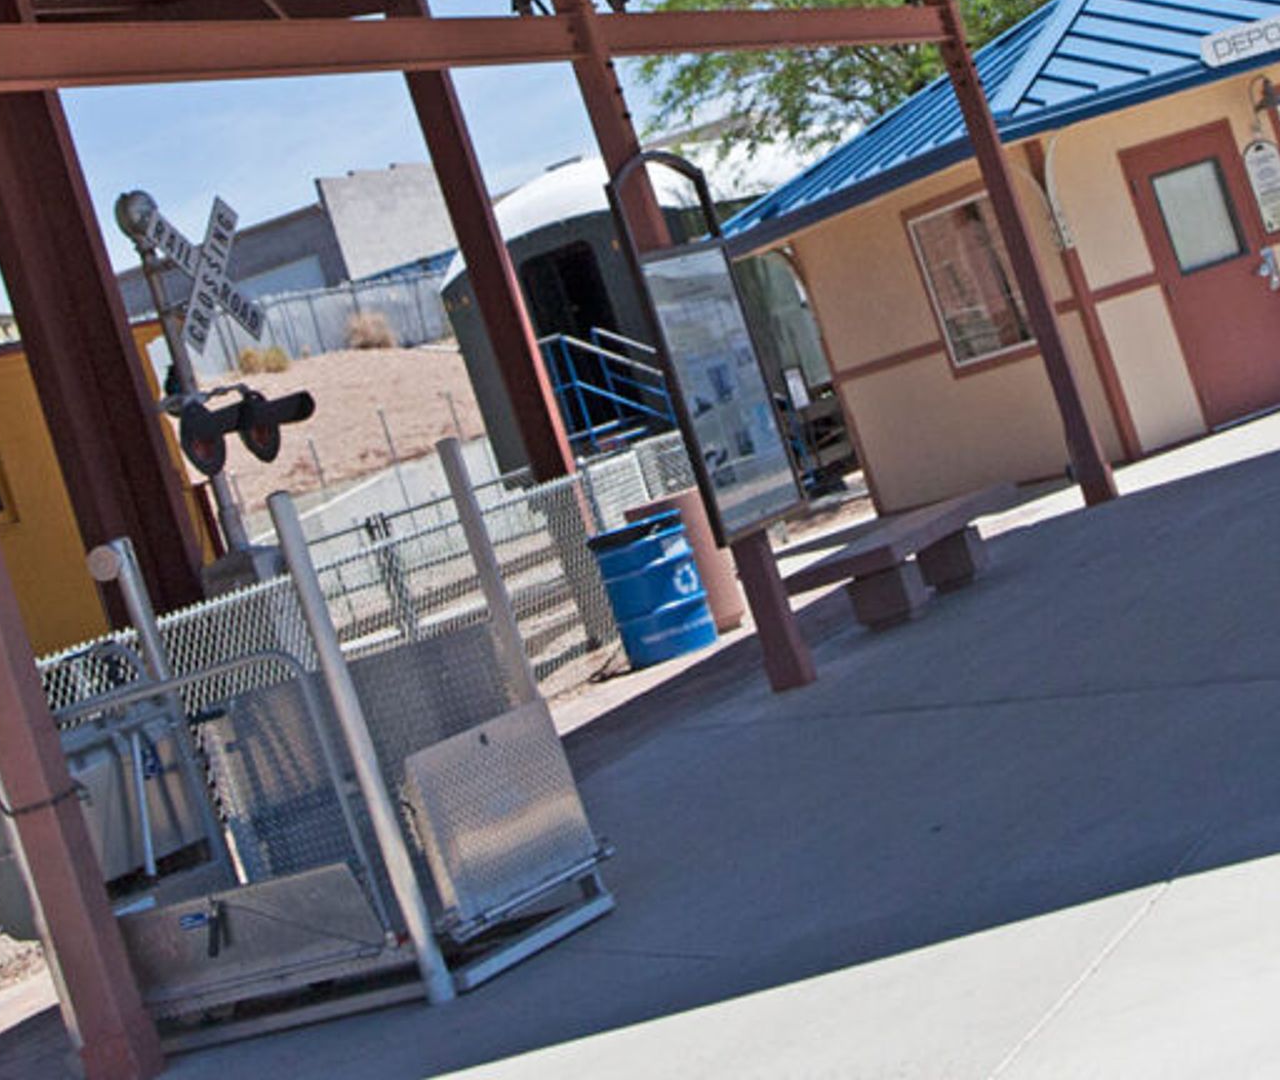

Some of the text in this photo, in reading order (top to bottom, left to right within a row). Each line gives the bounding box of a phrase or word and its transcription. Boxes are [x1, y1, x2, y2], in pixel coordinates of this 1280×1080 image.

[154, 219, 261, 332] RAIL ROAD
[186, 212, 234, 344] CROSSING
